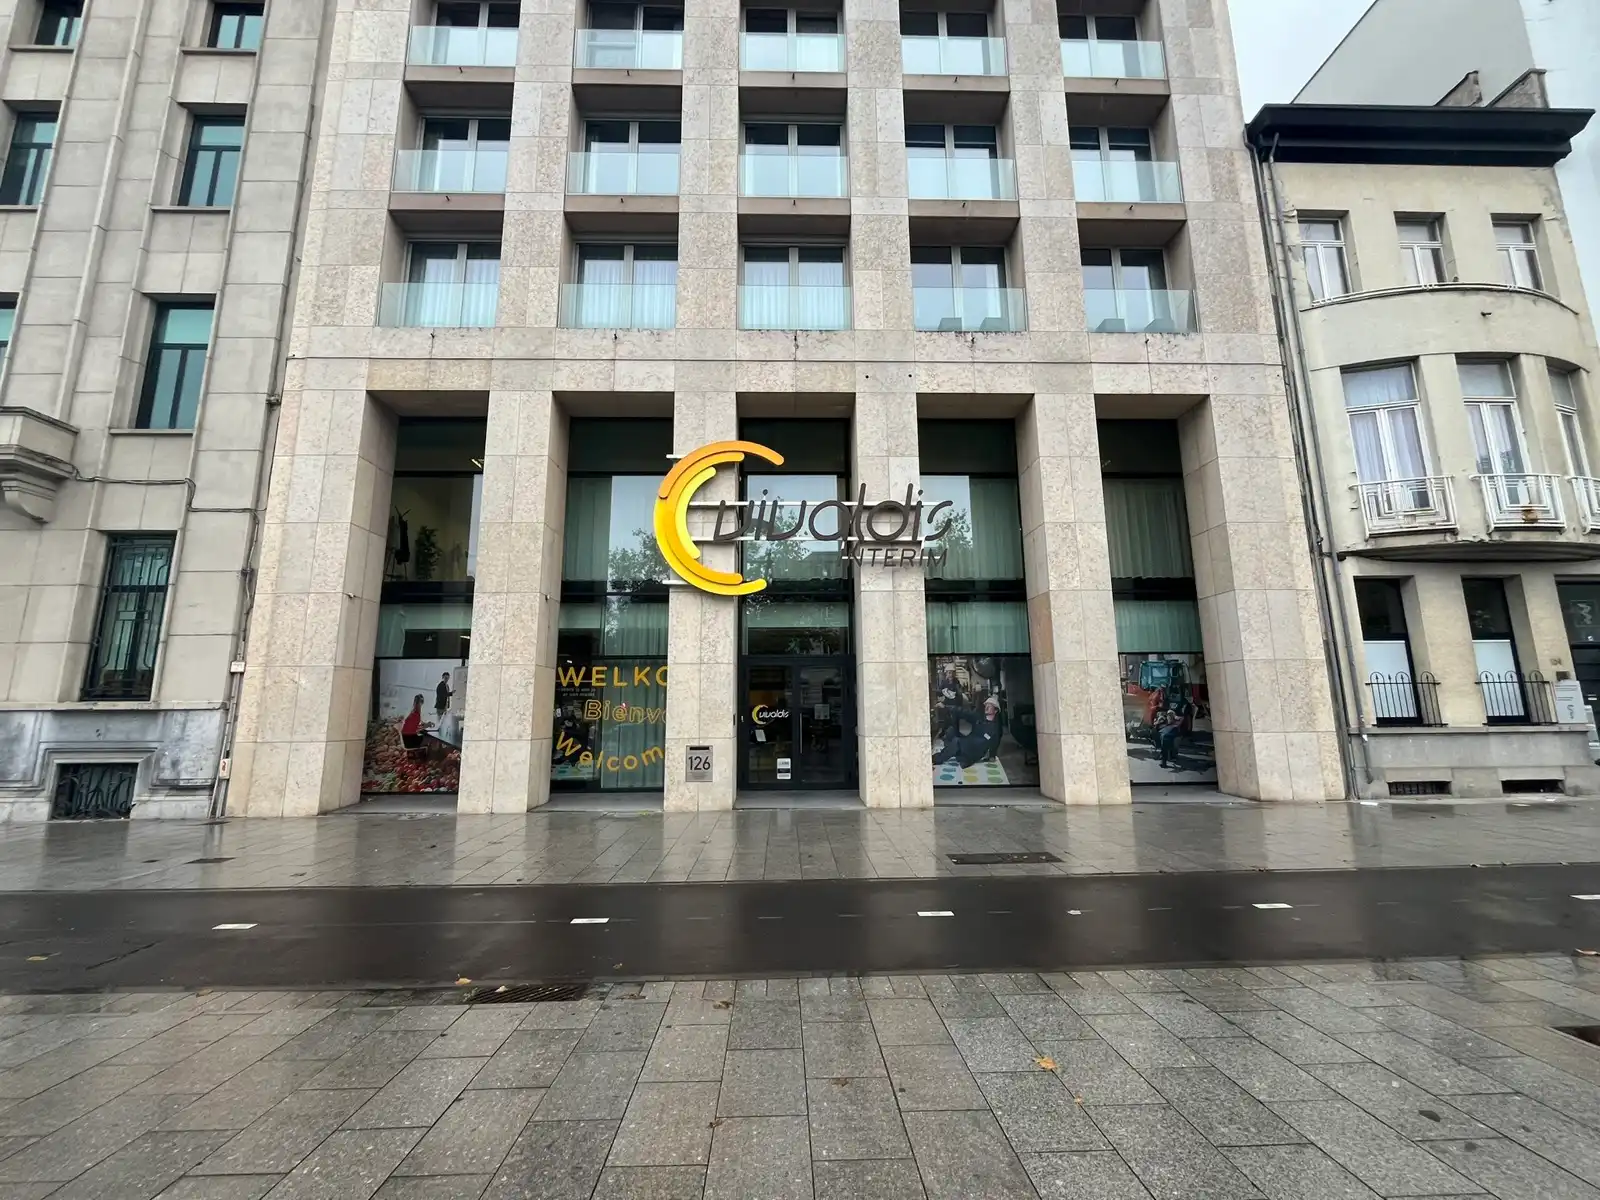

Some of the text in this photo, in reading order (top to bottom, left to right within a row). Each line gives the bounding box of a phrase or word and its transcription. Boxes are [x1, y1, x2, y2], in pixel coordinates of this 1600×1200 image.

[839, 547, 948, 567] INTERIM
[584, 699, 667, 724] Bienv
[688, 756, 711, 770] 126
